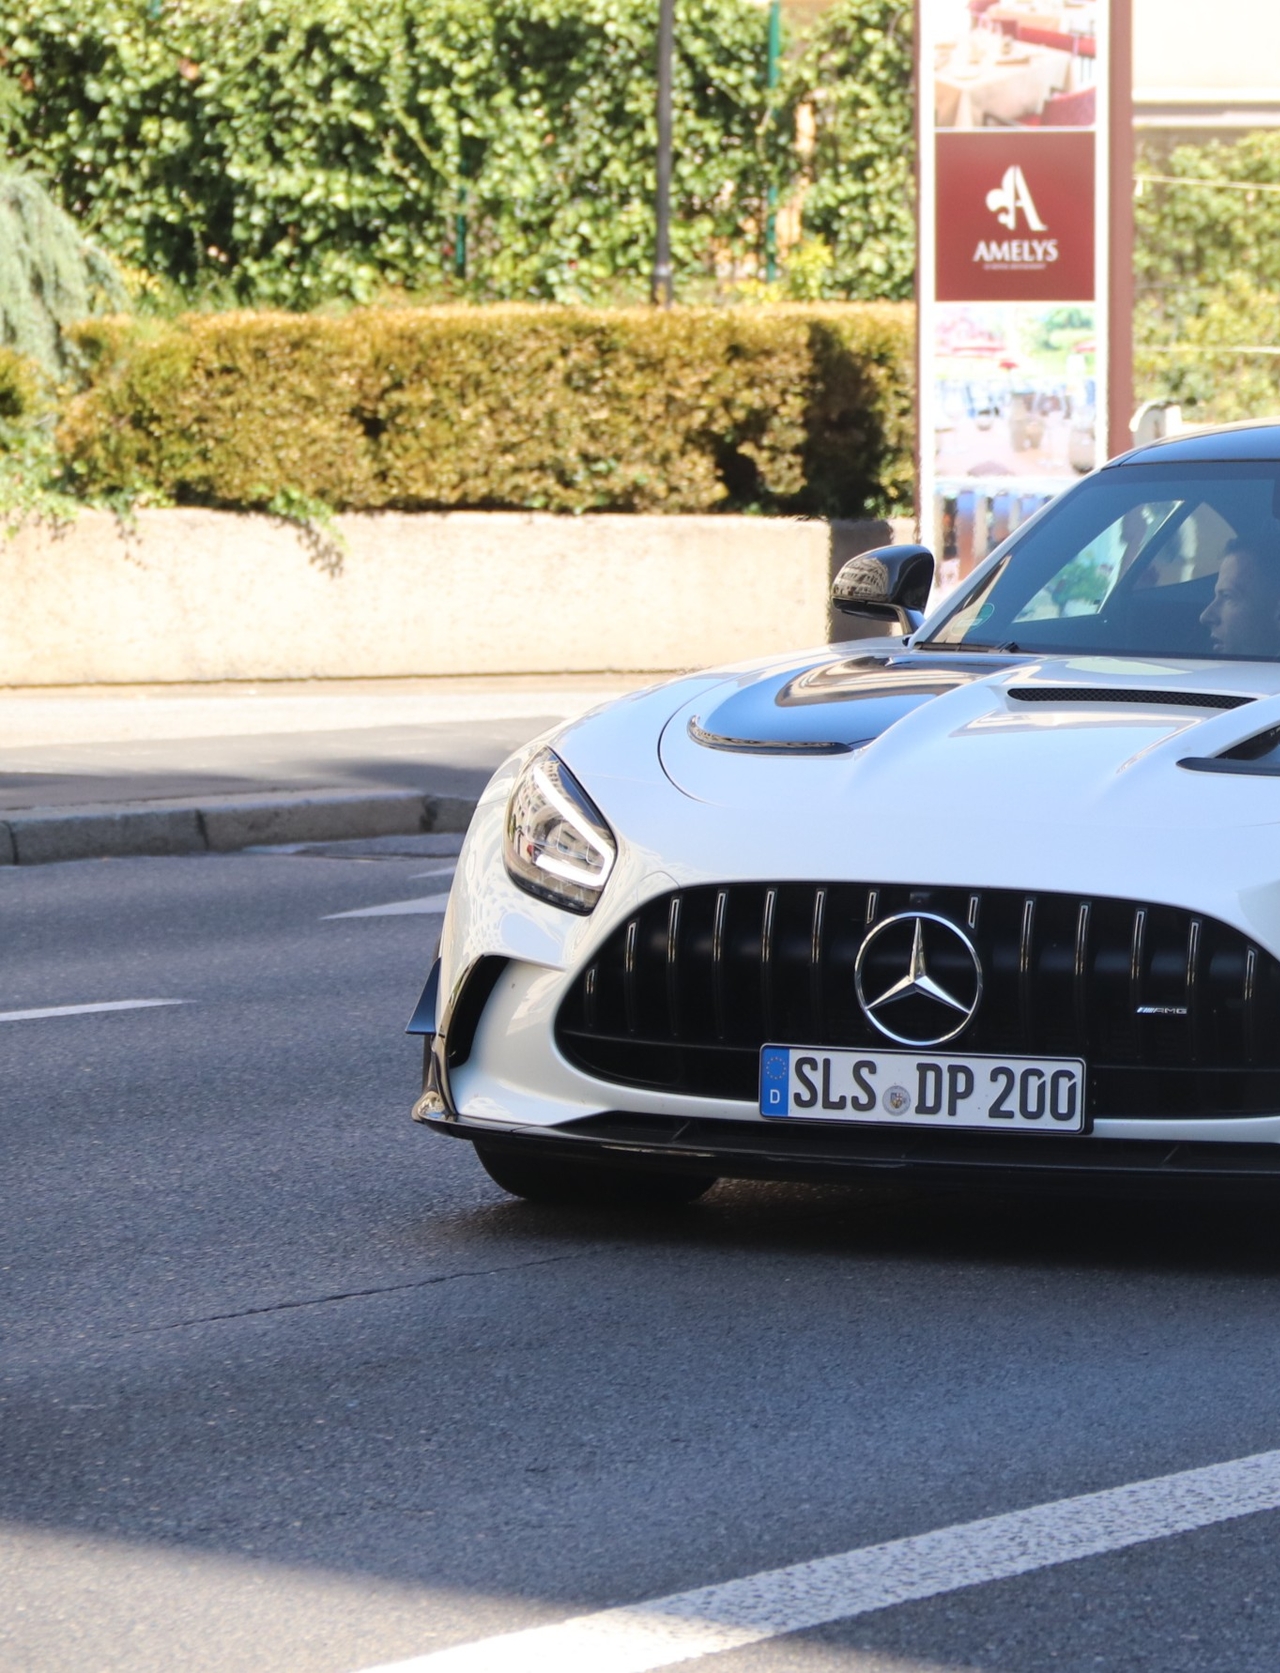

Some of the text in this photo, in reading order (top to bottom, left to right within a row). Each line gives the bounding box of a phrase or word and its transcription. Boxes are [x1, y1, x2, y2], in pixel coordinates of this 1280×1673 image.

[973, 239, 1059, 262] AMELYS
[769, 1089, 780, 1104] D
[793, 1056, 877, 1111] SLS
[914, 1062, 974, 1117] DP
[988, 1066, 1077, 1121] 200
